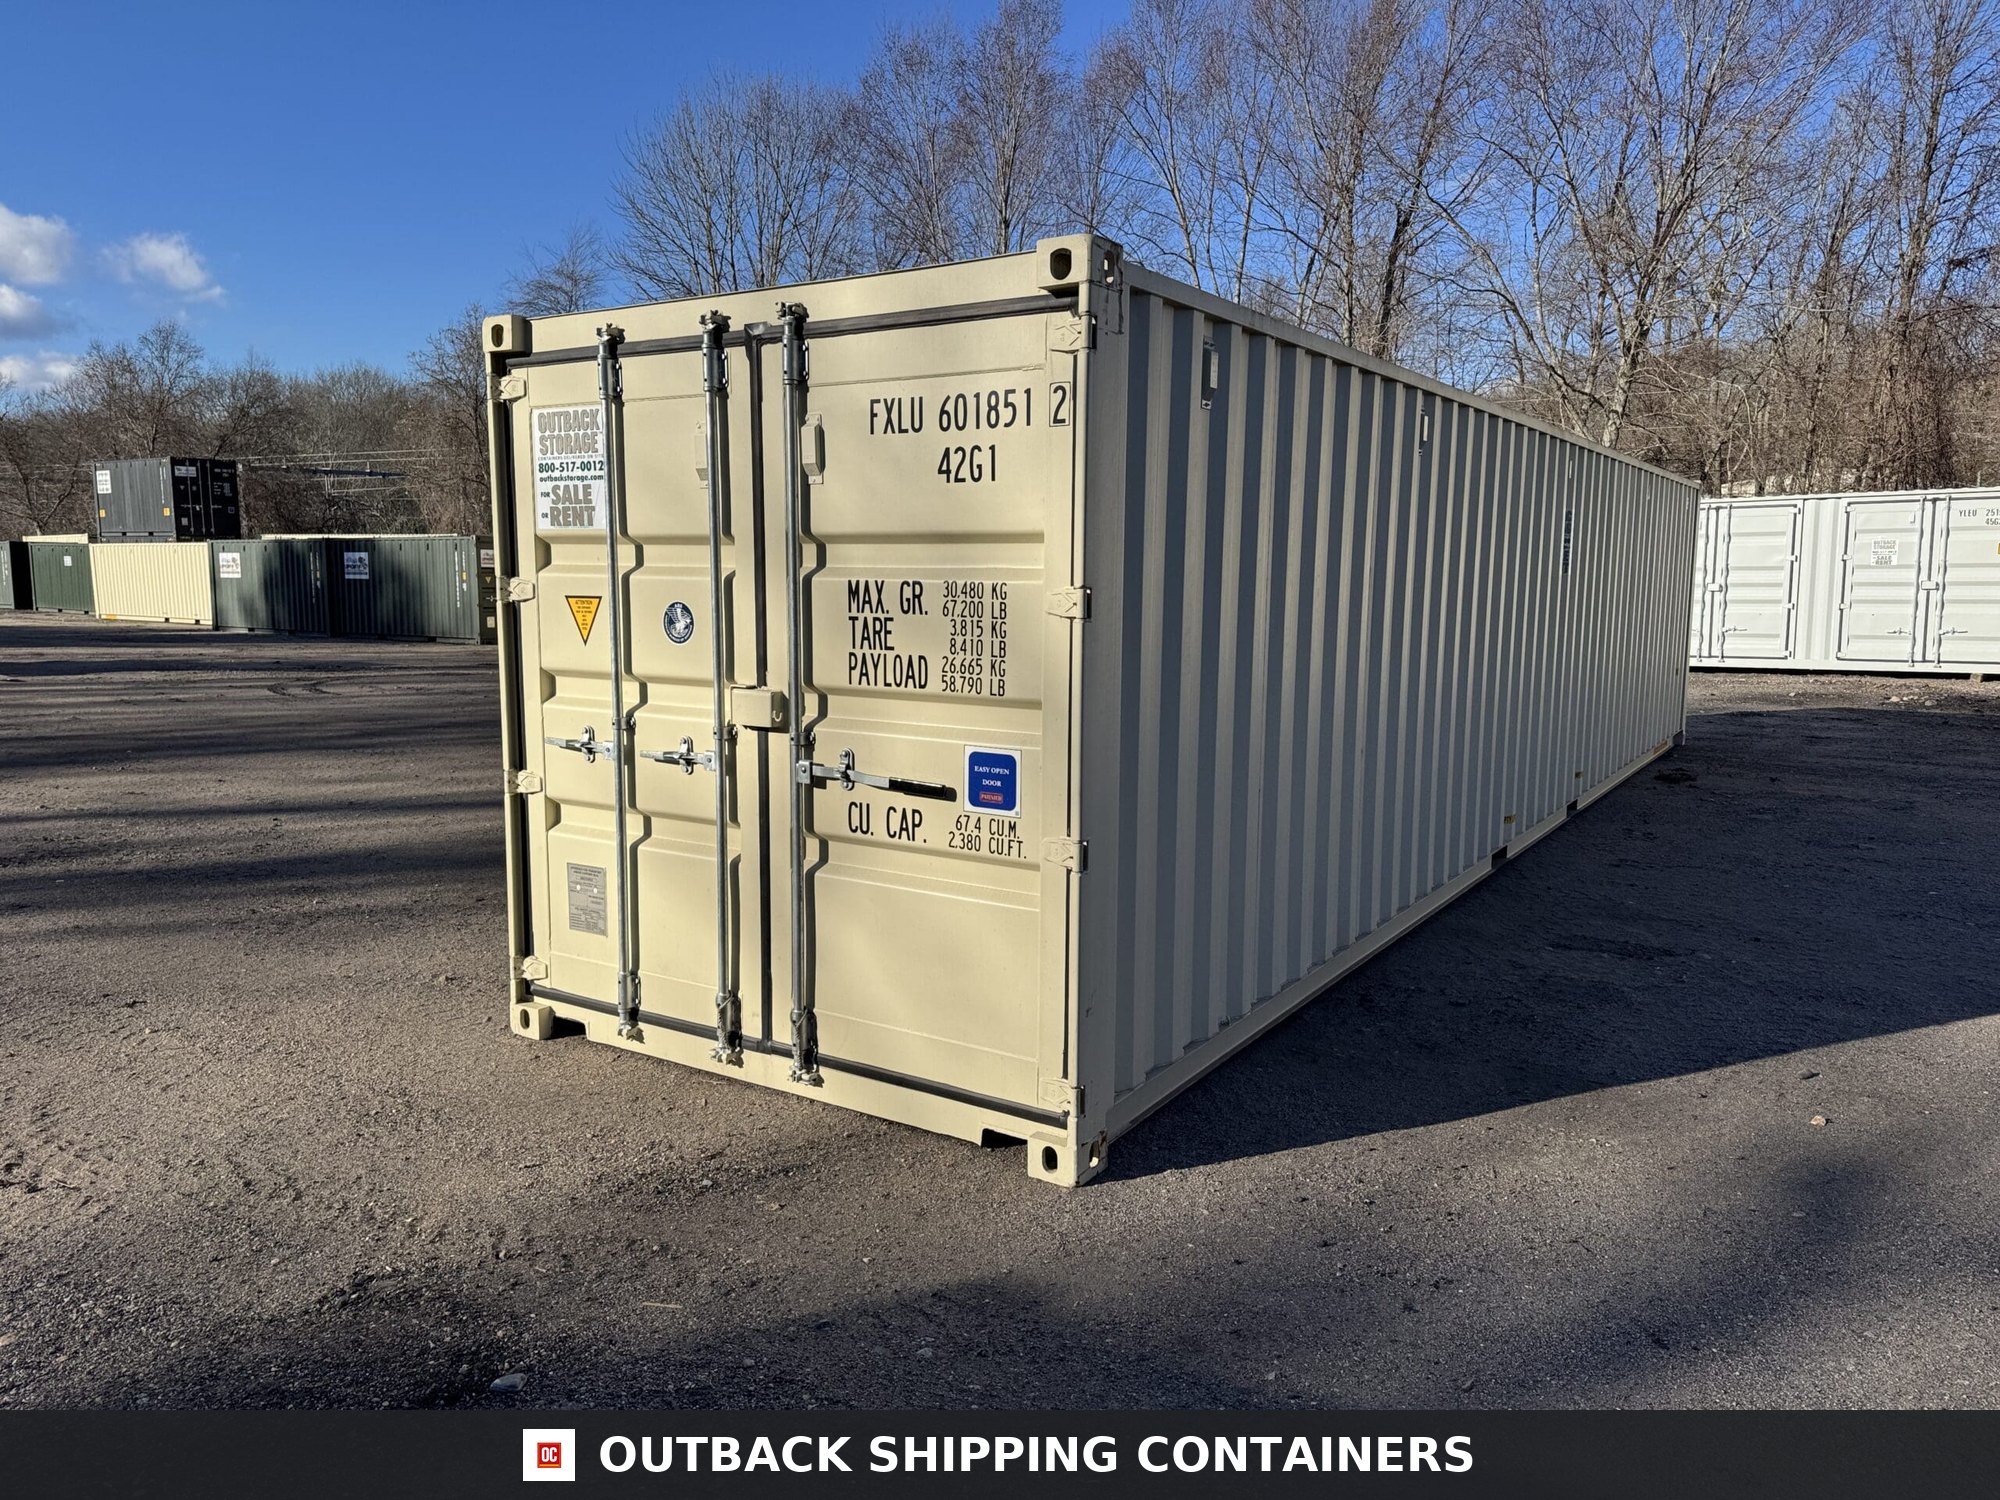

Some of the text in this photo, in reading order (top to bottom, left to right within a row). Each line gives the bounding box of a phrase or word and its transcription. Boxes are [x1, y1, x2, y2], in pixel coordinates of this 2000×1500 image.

[869, 384, 1068, 435] FXLU 601851 2
[537, 408, 601, 434] OUTBACK
[539, 431, 599, 456] STORAGE
[538, 460, 604, 473] 800-517-0012
[937, 444, 996, 483] 42G1
[539, 473, 604, 483] outbackstorage.com
[551, 483, 593, 506] SALE
[549, 505, 596, 527] RENT
[1985, 508, 2000, 517] 251
[1985, 517, 2000, 526] 45G
[847, 579, 890, 614] MAX.
[899, 580, 929, 615] GR.
[991, 582, 1007, 600] KG
[991, 601, 1007, 620] LB
[848, 616, 895, 651] TARE
[991, 621, 1007, 639] KG
[991, 639, 1007, 658] LB
[848, 652, 929, 689] PAYLOAD
[990, 659, 1006, 677] KG
[989, 678, 1005, 697] LB
[974, 765, 1010, 775] EASY OPEN
[982, 779, 1002, 787] DOOR
[848, 801, 874, 836] CU.
[886, 806, 927, 844] CAP.
[955, 815, 981, 834] 67.4
